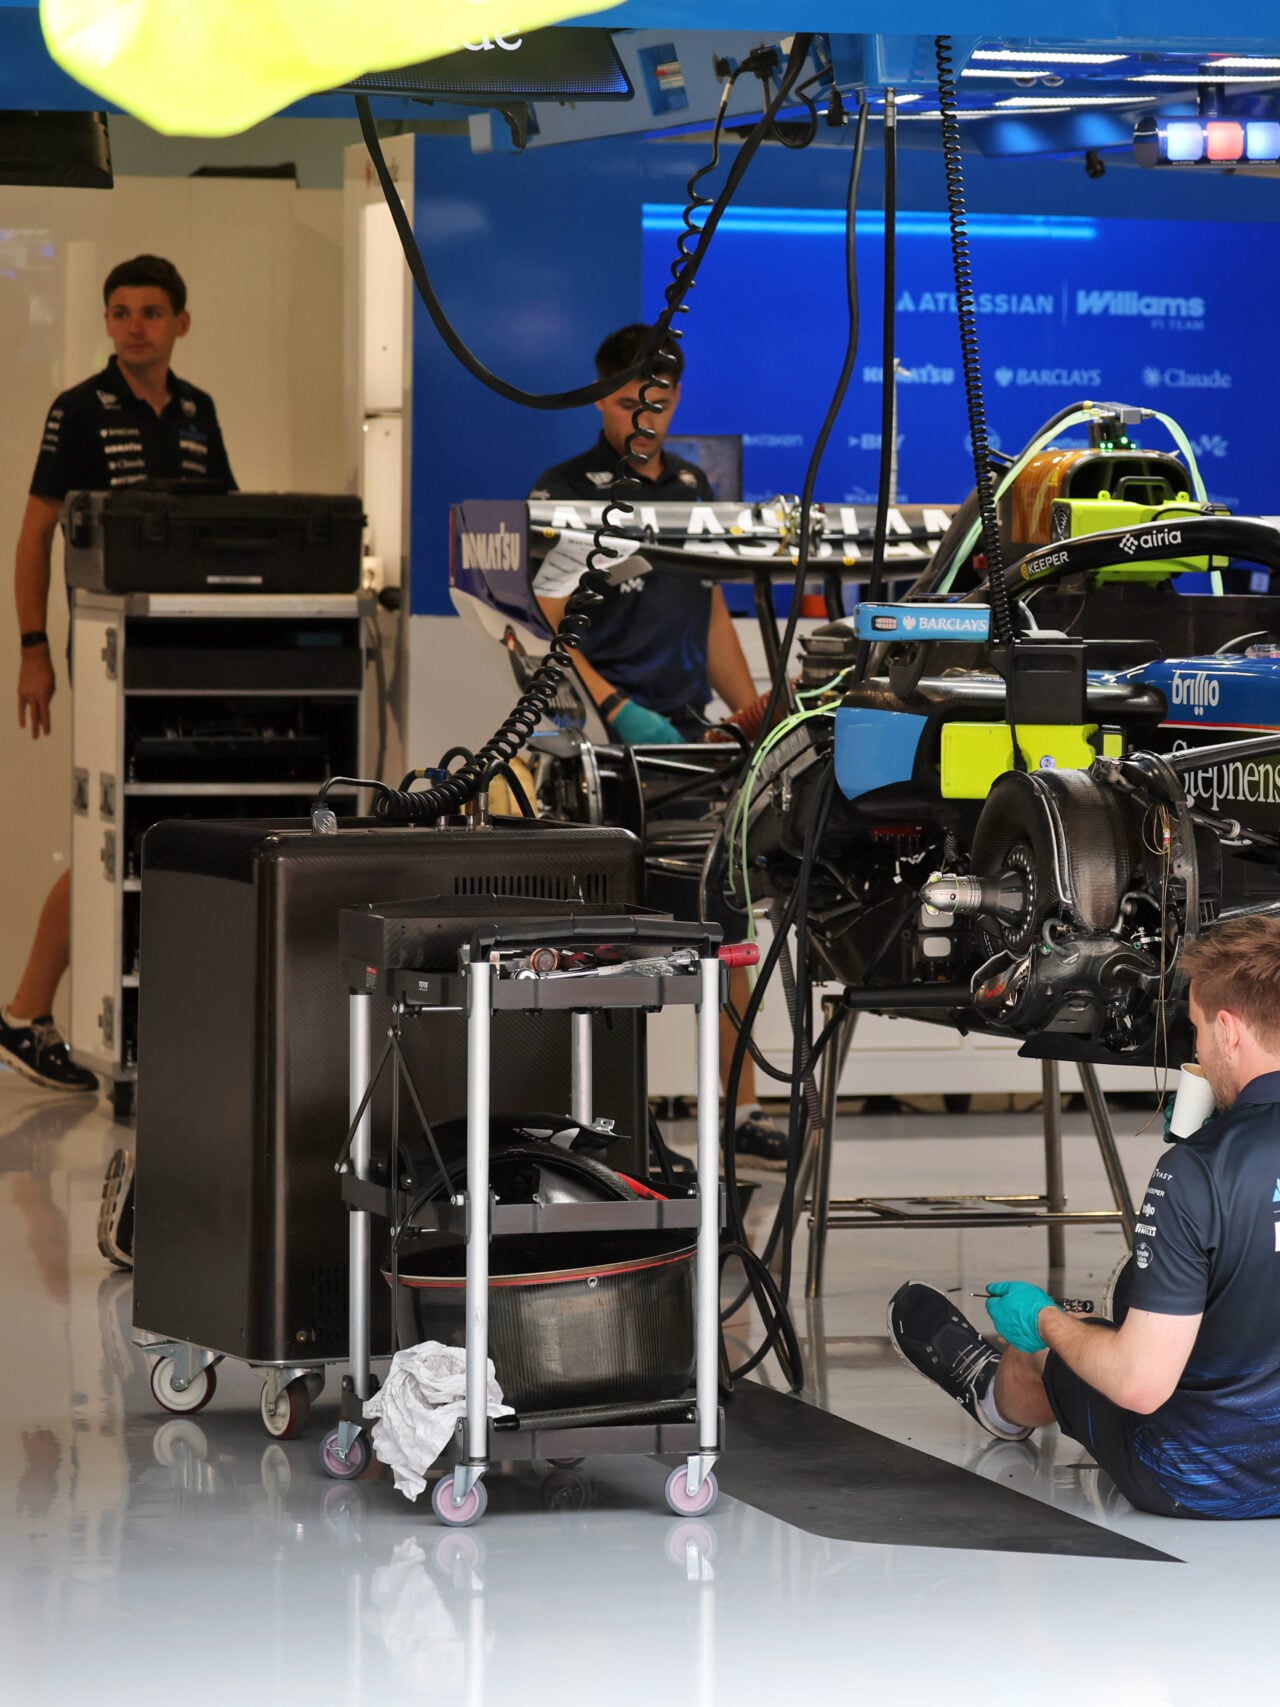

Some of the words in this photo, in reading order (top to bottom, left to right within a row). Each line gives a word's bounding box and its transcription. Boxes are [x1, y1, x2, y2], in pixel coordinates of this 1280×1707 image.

[918, 292, 1054, 314] ATLSSIAN
[1076, 289, 1206, 318] Williams
[863, 364, 955, 385] KATSU
[1015, 367, 1101, 386] BARCLAYS
[1163, 368, 1232, 388] Claude
[1140, 528, 1182, 549] airia
[1027, 551, 1070, 576] KEEPER
[919, 617, 988, 632] BARCLAYS
